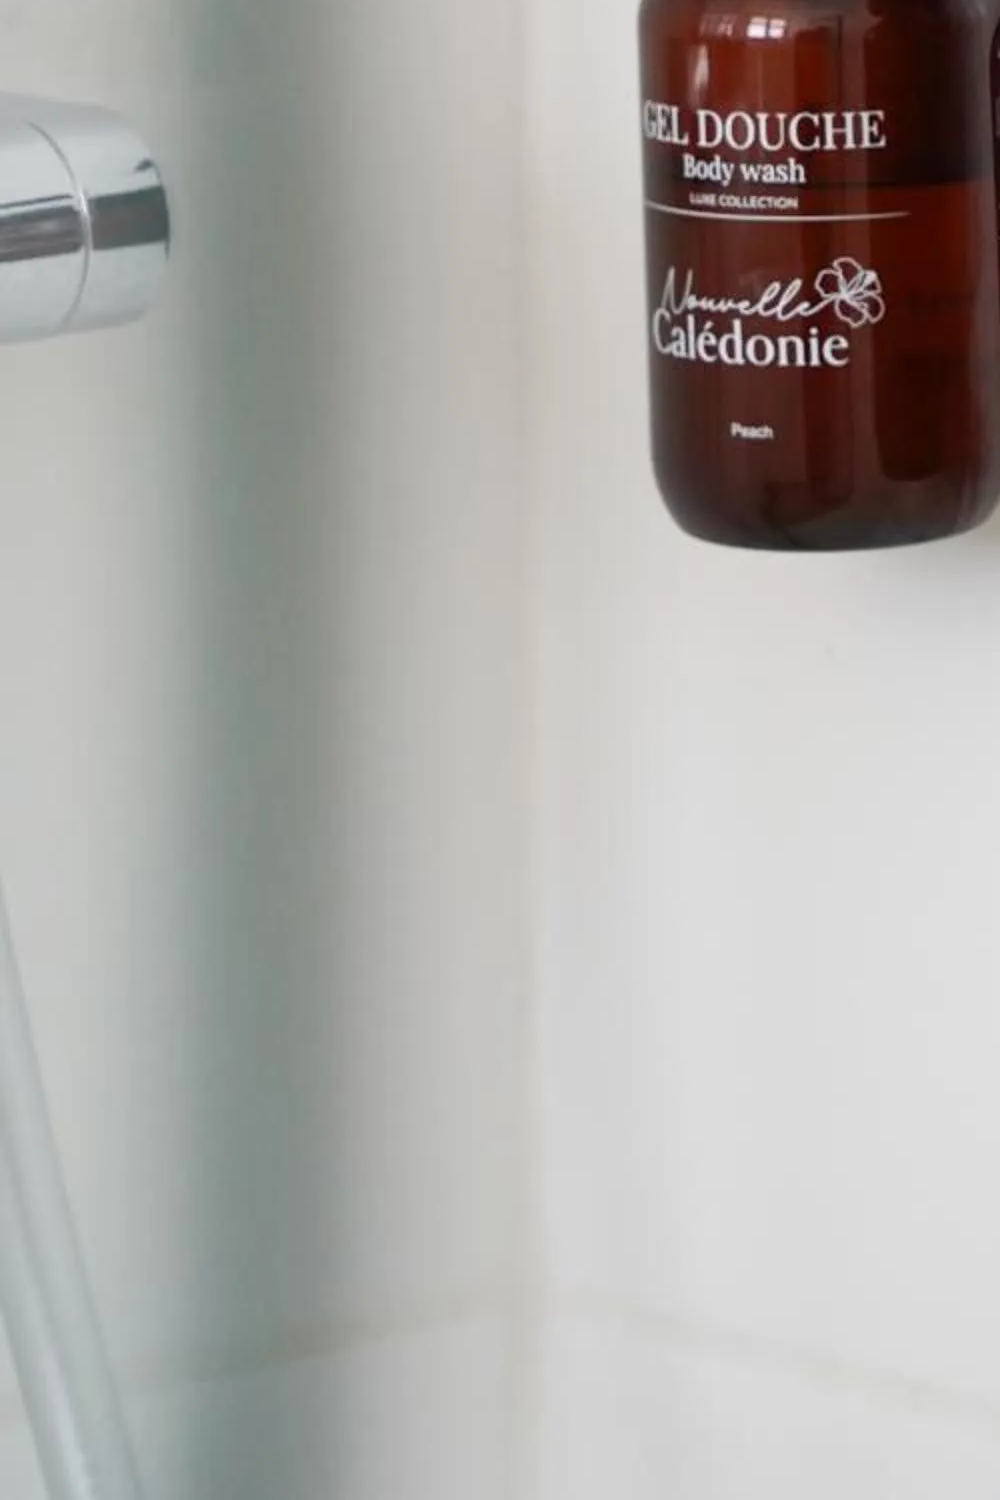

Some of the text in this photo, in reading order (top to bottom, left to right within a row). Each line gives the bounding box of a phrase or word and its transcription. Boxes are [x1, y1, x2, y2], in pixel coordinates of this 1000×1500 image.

[643, 99, 887, 151] GEL DOUCHE
[682, 153, 806, 187] Body wash
[689, 191, 798, 210] LUXE COLLECTION
[659, 266, 832, 322] Nouvelle
[653, 307, 850, 368] Calédonie
[731, 421, 774, 440] Peach
